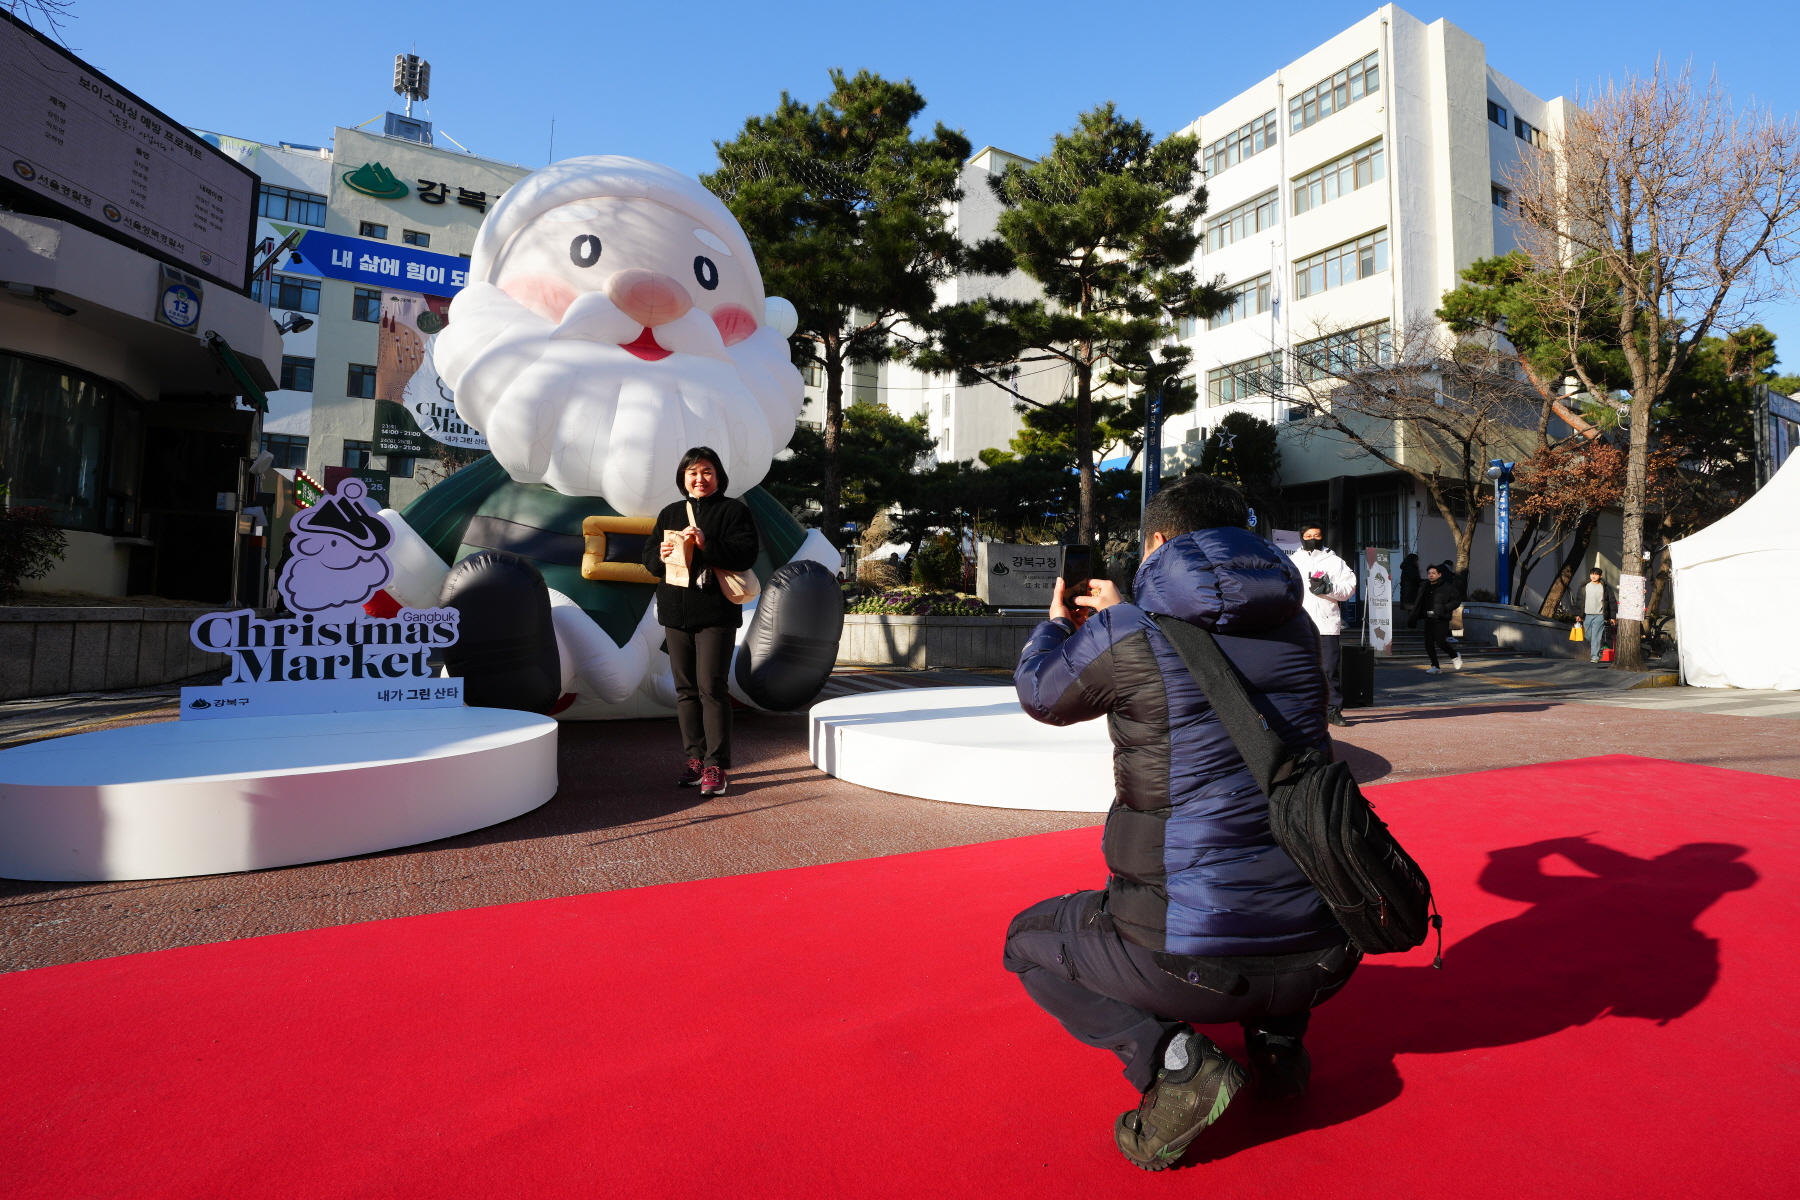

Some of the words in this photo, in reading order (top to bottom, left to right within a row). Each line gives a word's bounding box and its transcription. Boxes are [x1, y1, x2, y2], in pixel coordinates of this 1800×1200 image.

[49, 95, 66, 111] 제작
[79, 76, 137, 121] 보이스피싱
[141, 115, 162, 136] 예방
[164, 130, 202, 161] 프로젝트
[38, 173, 91, 206] 서울경찰청
[416, 178, 501, 214] 강북
[124, 216, 184, 251] 서울성북경찰서
[331, 248, 352, 268] 내
[359, 252, 399, 277] 삶에
[406, 261, 444, 286] 힘이
[173, 300, 189, 314] 13
[416, 402, 460, 419] Chr
[428, 416, 480, 436] Mar
[460, 436, 473, 444] 그린
[1012, 556, 1057, 568] 강북구청
[402, 612, 455, 624] Gangbuk
[197, 614, 455, 648] Christmas
[232, 644, 428, 683] Market
[213, 698, 250, 708] 강북구
[378, 690, 403, 702] 내가
[406, 688, 430, 701] 그린
[434, 687, 459, 700] 산타
